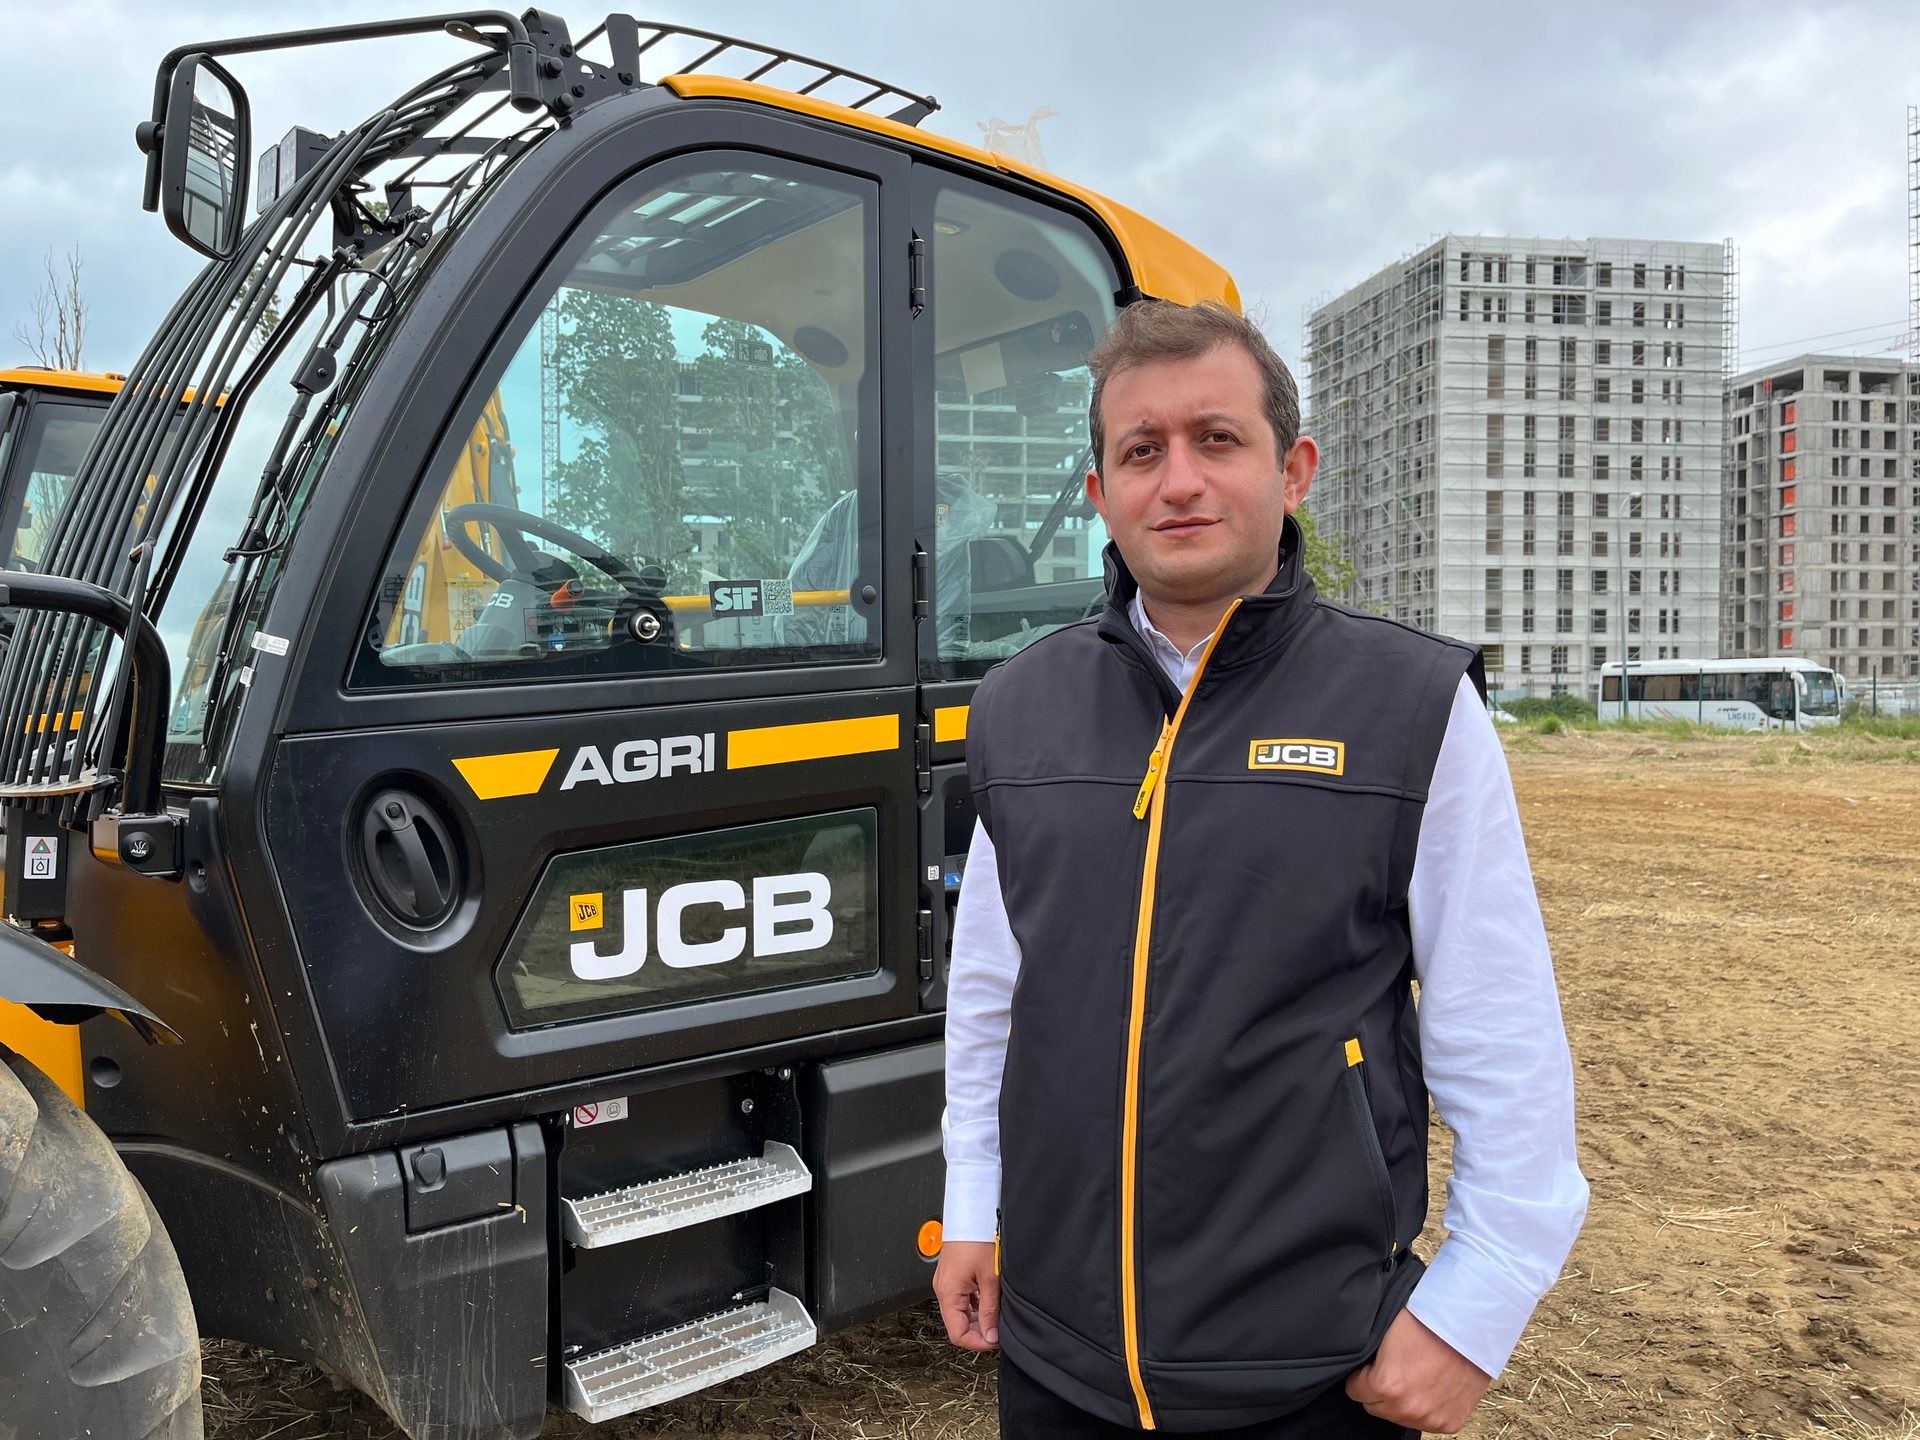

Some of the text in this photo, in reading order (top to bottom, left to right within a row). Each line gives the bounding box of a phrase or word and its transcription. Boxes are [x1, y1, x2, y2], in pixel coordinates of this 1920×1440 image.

[560, 732, 715, 791] AGRI
[1257, 745, 1336, 767] JCB
[570, 872, 834, 981] JCB
[578, 904, 597, 921] JCB
